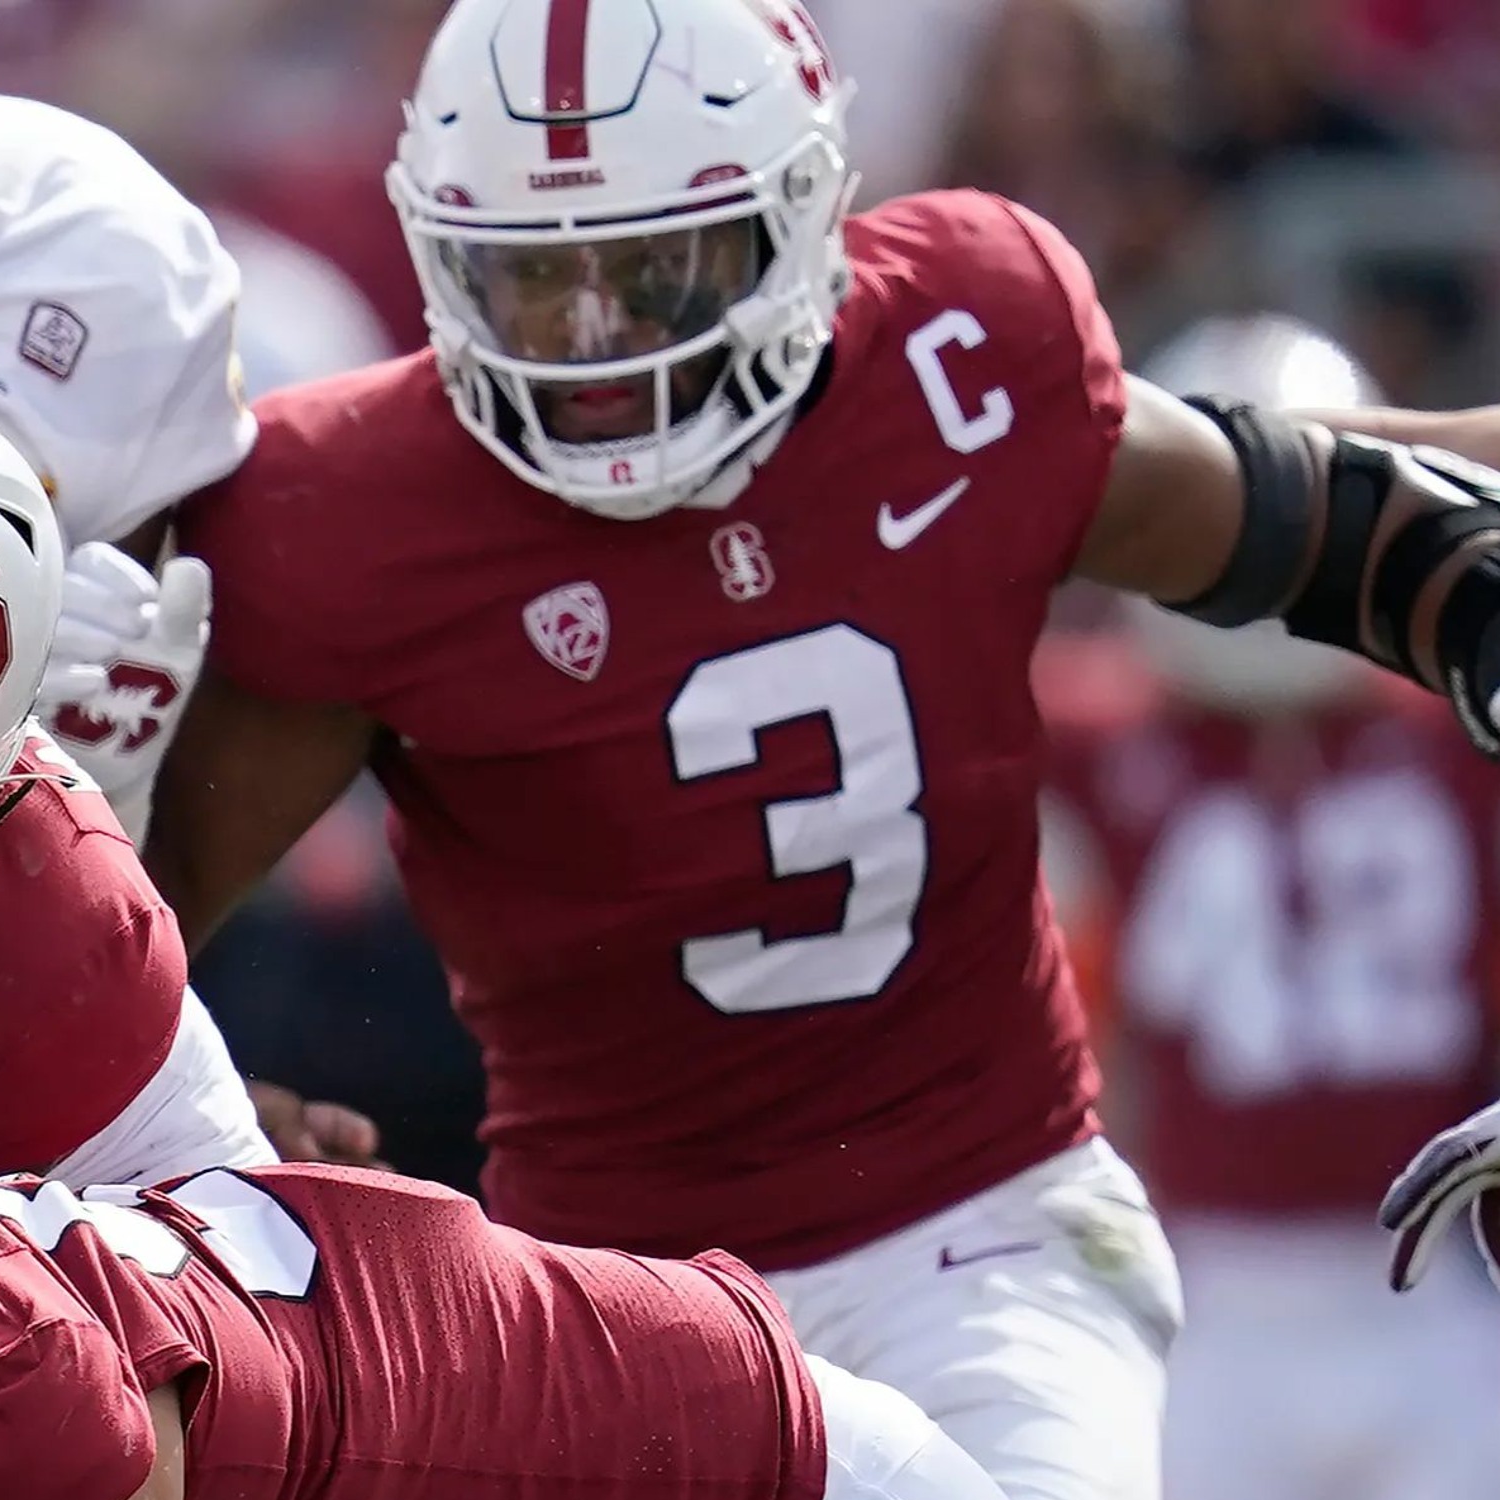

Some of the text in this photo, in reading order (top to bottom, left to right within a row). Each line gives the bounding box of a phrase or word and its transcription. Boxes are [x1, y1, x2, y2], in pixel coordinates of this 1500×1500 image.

[904, 309, 1015, 454] C
[662, 620, 930, 1015] 3
[1115, 778, 1478, 1098] 42
